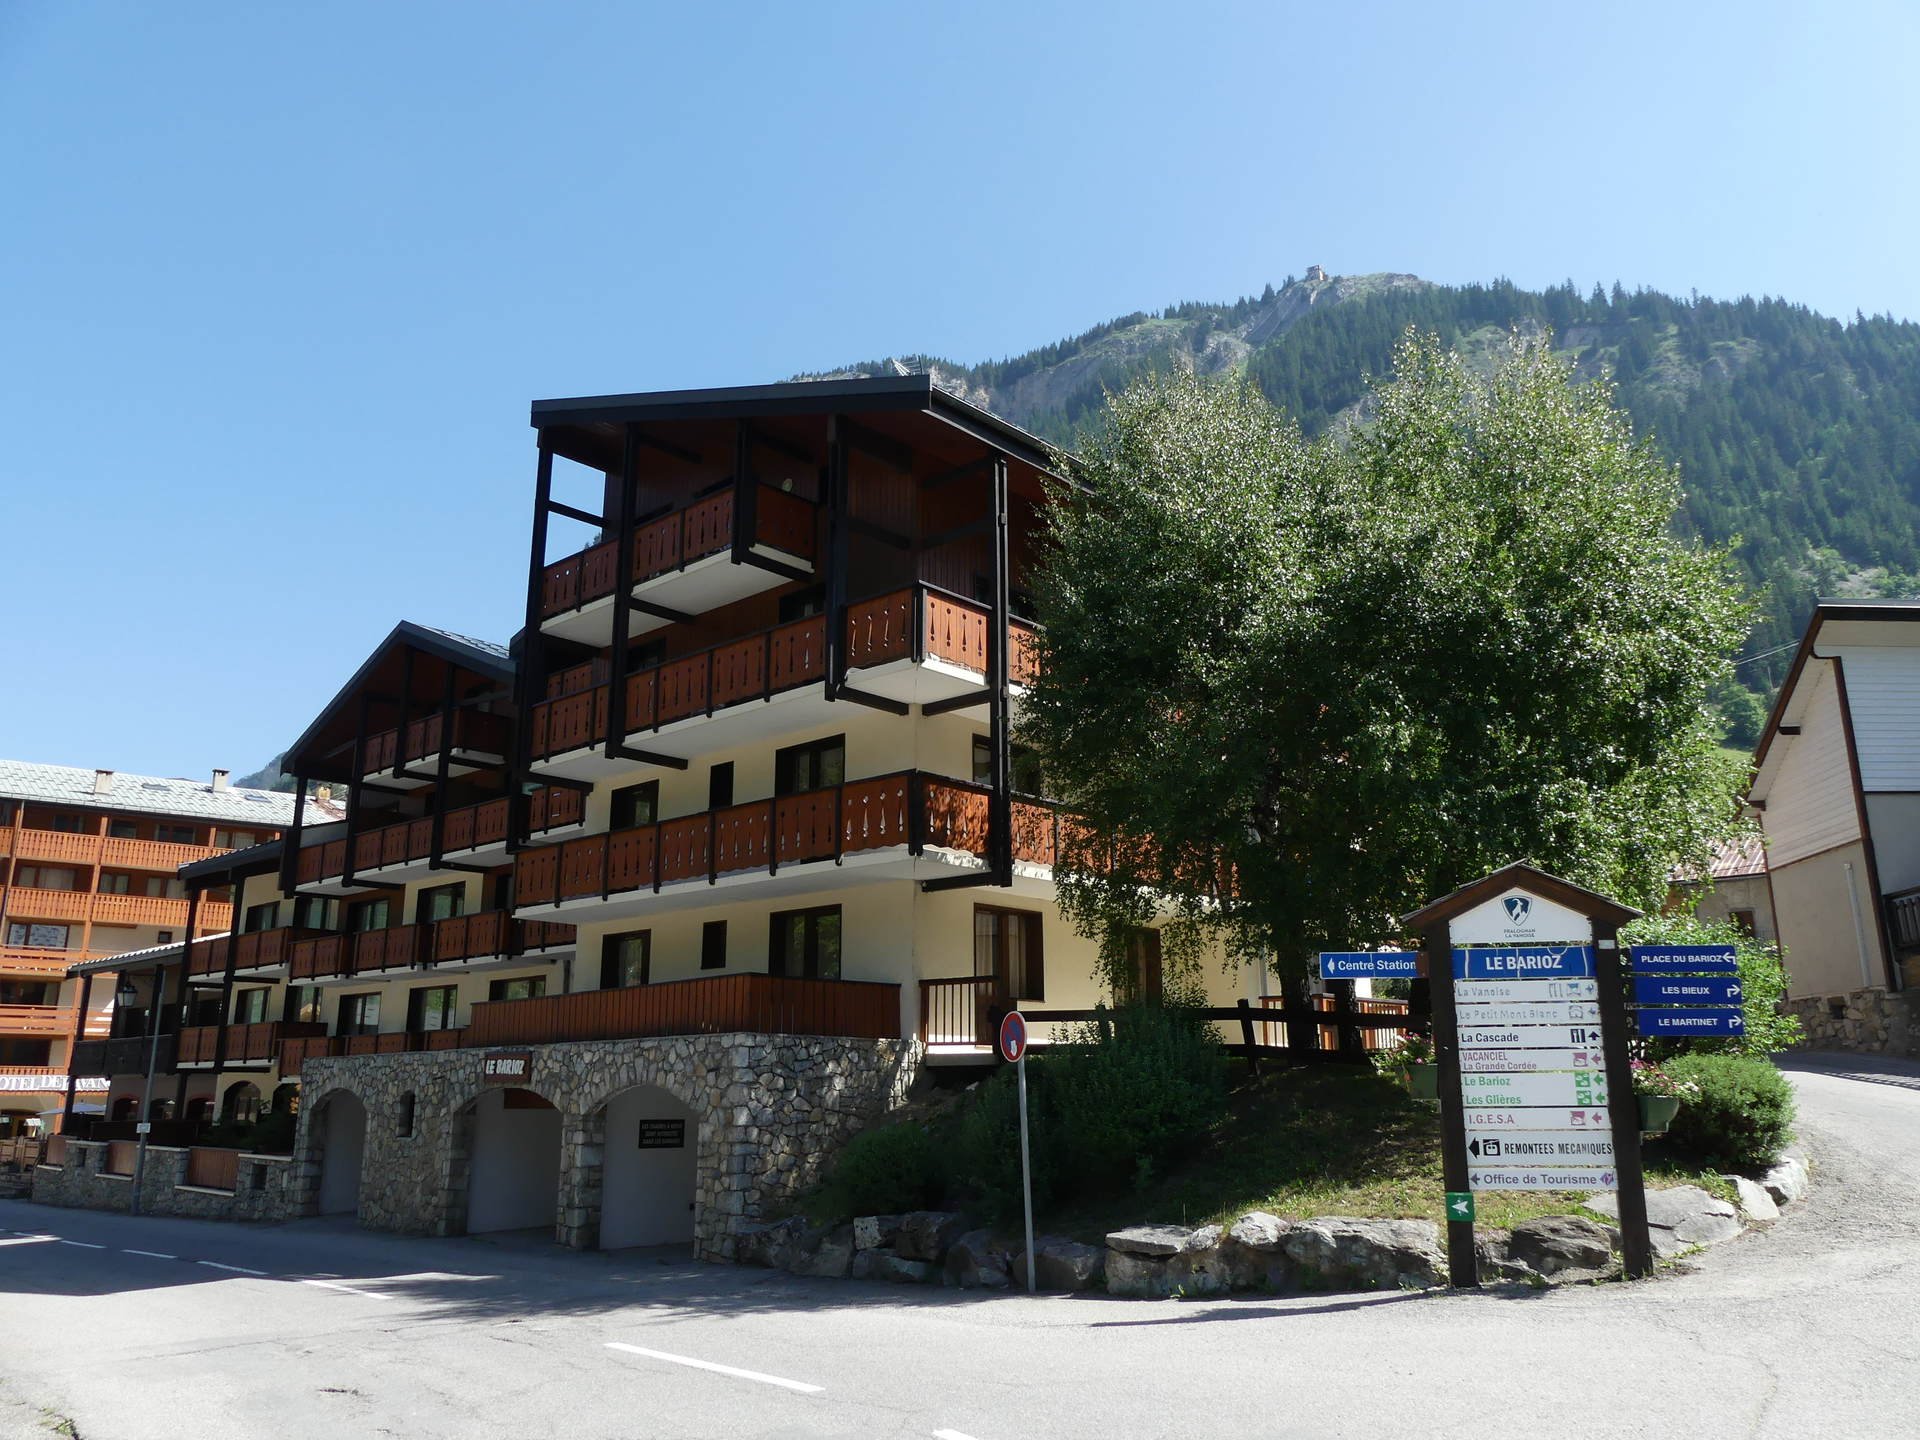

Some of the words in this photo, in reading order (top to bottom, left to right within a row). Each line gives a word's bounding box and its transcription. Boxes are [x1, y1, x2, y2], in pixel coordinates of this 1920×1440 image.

[1485, 956, 1504, 971] LE
[1507, 954, 1563, 970] BARIOZ
[1641, 955, 1671, 963] PLACE
[1672, 955, 1686, 963] DU
[1688, 955, 1723, 963] BARIOZ
[1338, 960, 1374, 971] Centre
[1376, 959, 1417, 970] Station
[1457, 988, 1469, 997] La
[1472, 987, 1511, 997] Vanoise
[1661, 987, 1680, 995] LES
[1681, 987, 1710, 995] BIEUX
[1474, 1010, 1498, 1020] Petit
[1501, 1010, 1528, 1020] Mont
[1529, 1009, 1559, 1019] Blanc
[1658, 1018, 1670, 1026] LE
[1672, 1018, 1718, 1026] MARTINET
[1461, 1033, 1473, 1043] La
[1475, 1032, 1519, 1043] Cascade
[1462, 1051, 1508, 1062] VACANCIEL
[485, 1060, 496, 1075] LE
[496, 1059, 525, 1075] BARIOZ
[1463, 1062, 1475, 1070] La
[1475, 1062, 1506, 1070] Grande
[1507, 1061, 1537, 1070] Cordée
[1464, 1077, 1476, 1086] Le
[1478, 1076, 1511, 1086] Barioz
[1466, 1095, 1484, 1105] Les
[1486, 1093, 1522, 1104] Glières
[1504, 1143, 1554, 1155] REMONTEES
[1558, 1142, 1612, 1155] MECANIQUES
[1483, 1173, 1519, 1185] Office
[1522, 1173, 1537, 1184] de
[1540, 1173, 1597, 1184] Tourisme
